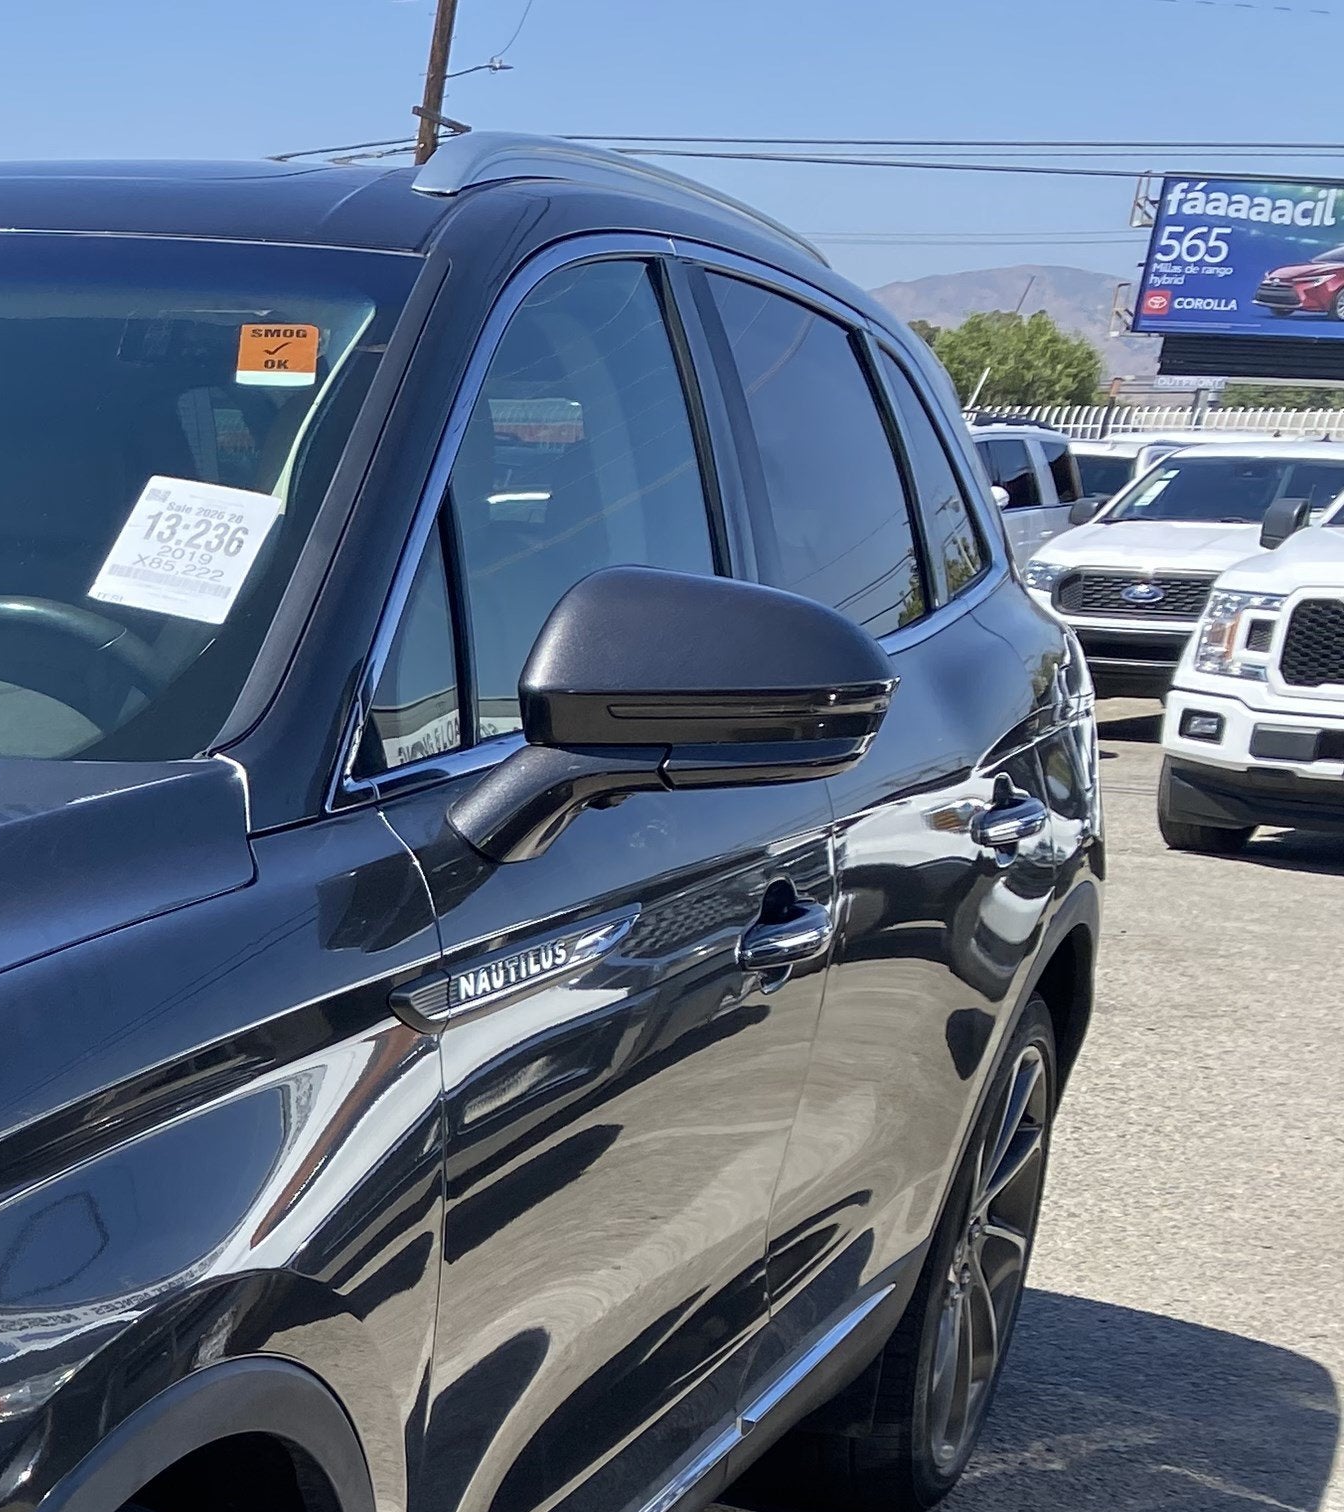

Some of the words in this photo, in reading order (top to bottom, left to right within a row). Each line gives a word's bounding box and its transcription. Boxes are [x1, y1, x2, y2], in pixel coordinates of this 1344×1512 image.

[1155, 226, 1232, 263] 565
[1152, 262, 1182, 274] Millas
[1184, 263, 1200, 274] de
[1201, 266, 1234, 278] rango
[1148, 273, 1186, 287] hybrid
[1173, 297, 1238, 311] COROLLA
[250, 328, 308, 339] SMOG
[263, 359, 289, 370] OK
[166, 501, 193, 514] Sale
[156, 545, 213, 565] 2019
[132, 553, 225, 582] X85,222
[458, 942, 568, 1000] NAUTILUS
